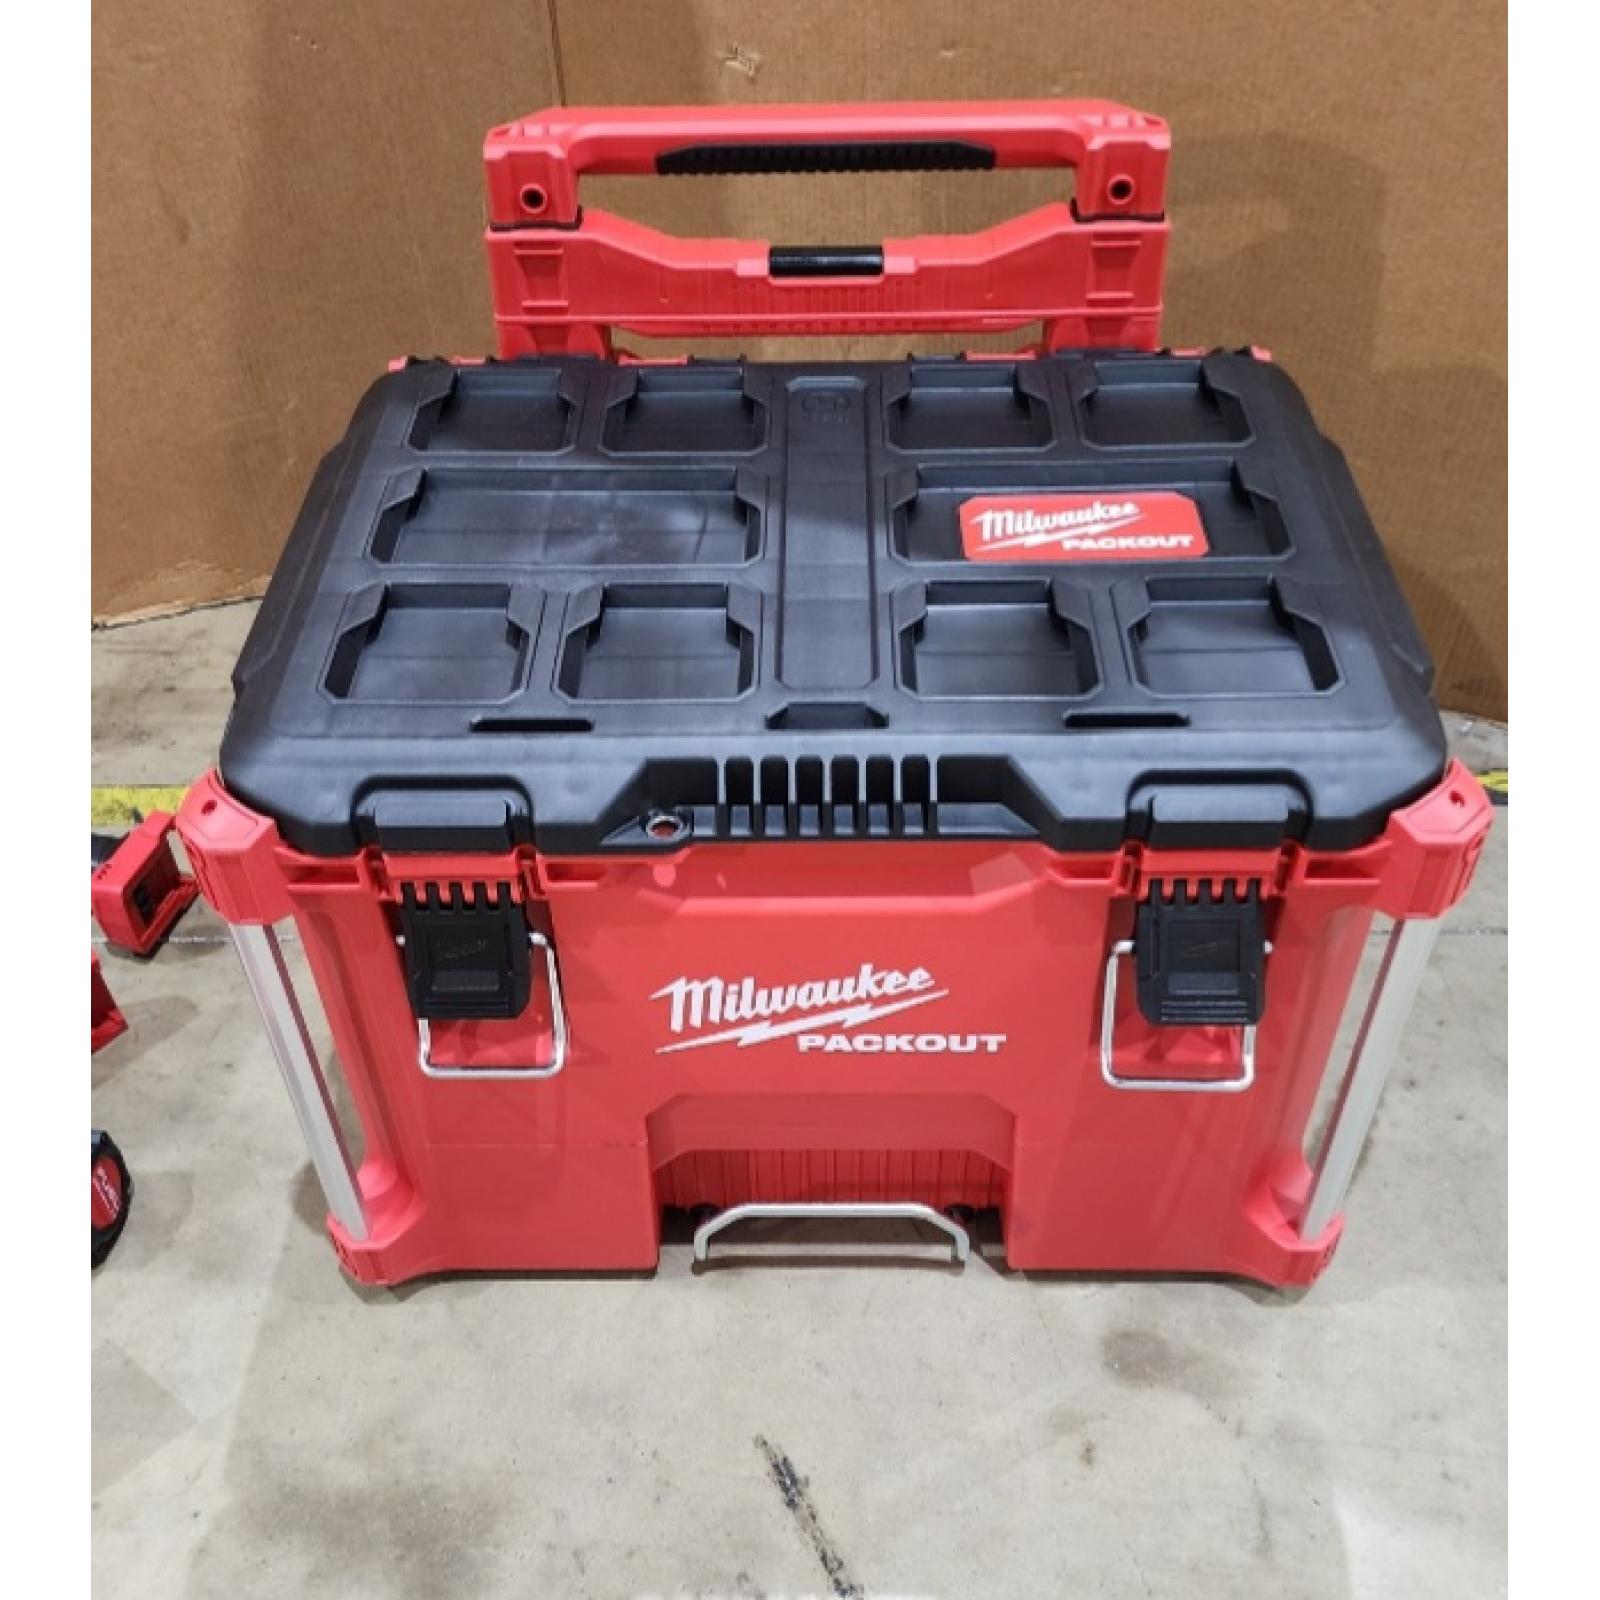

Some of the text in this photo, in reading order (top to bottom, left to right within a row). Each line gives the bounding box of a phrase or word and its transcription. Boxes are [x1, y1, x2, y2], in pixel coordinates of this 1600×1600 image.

[970, 501, 1140, 541] Milwaukee
[1062, 535, 1194, 551] PACKOUT
[650, 963, 935, 1033] Milwaukee
[799, 1033, 1007, 1053] PACKOUT
